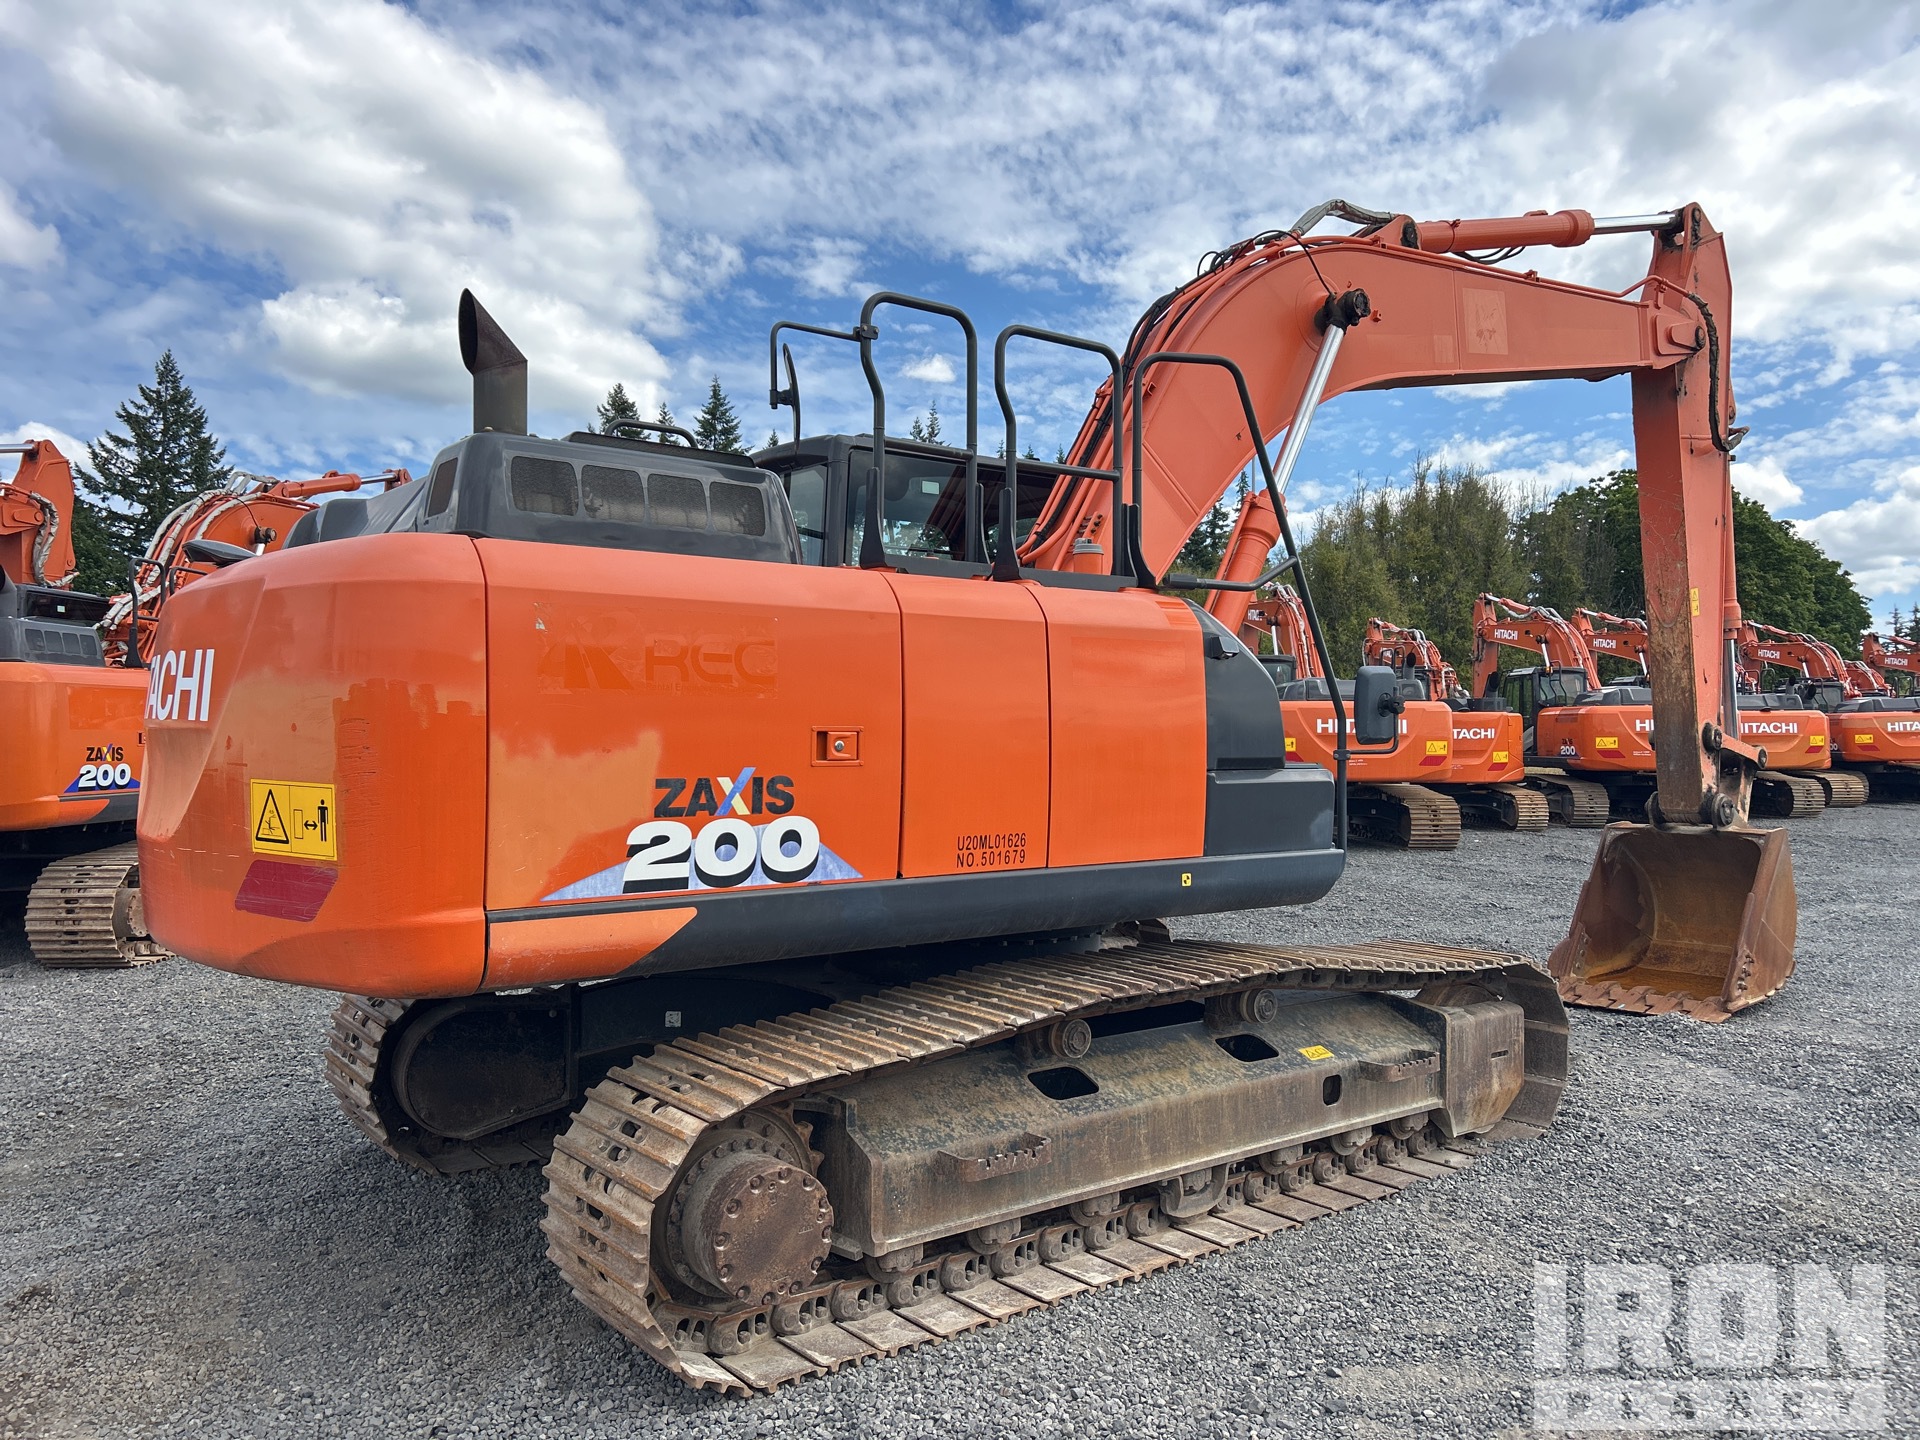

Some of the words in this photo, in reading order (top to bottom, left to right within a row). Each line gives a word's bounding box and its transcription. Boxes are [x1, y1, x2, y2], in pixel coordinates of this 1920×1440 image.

[1494, 629, 1519, 640] HITACHI
[1592, 638, 1617, 649] HITACHI
[1757, 649, 1780, 659] HITACHI
[1884, 657, 1909, 666] HITACHI
[86, 743, 124, 762] ZAXIS
[1560, 745, 1576, 756] 200
[78, 763, 131, 792] 200
[653, 767, 796, 818] ZAXIS
[956, 832, 1027, 851] U20ML01626
[622, 815, 820, 894] 200
[956, 848, 1026, 868] NO.501679
